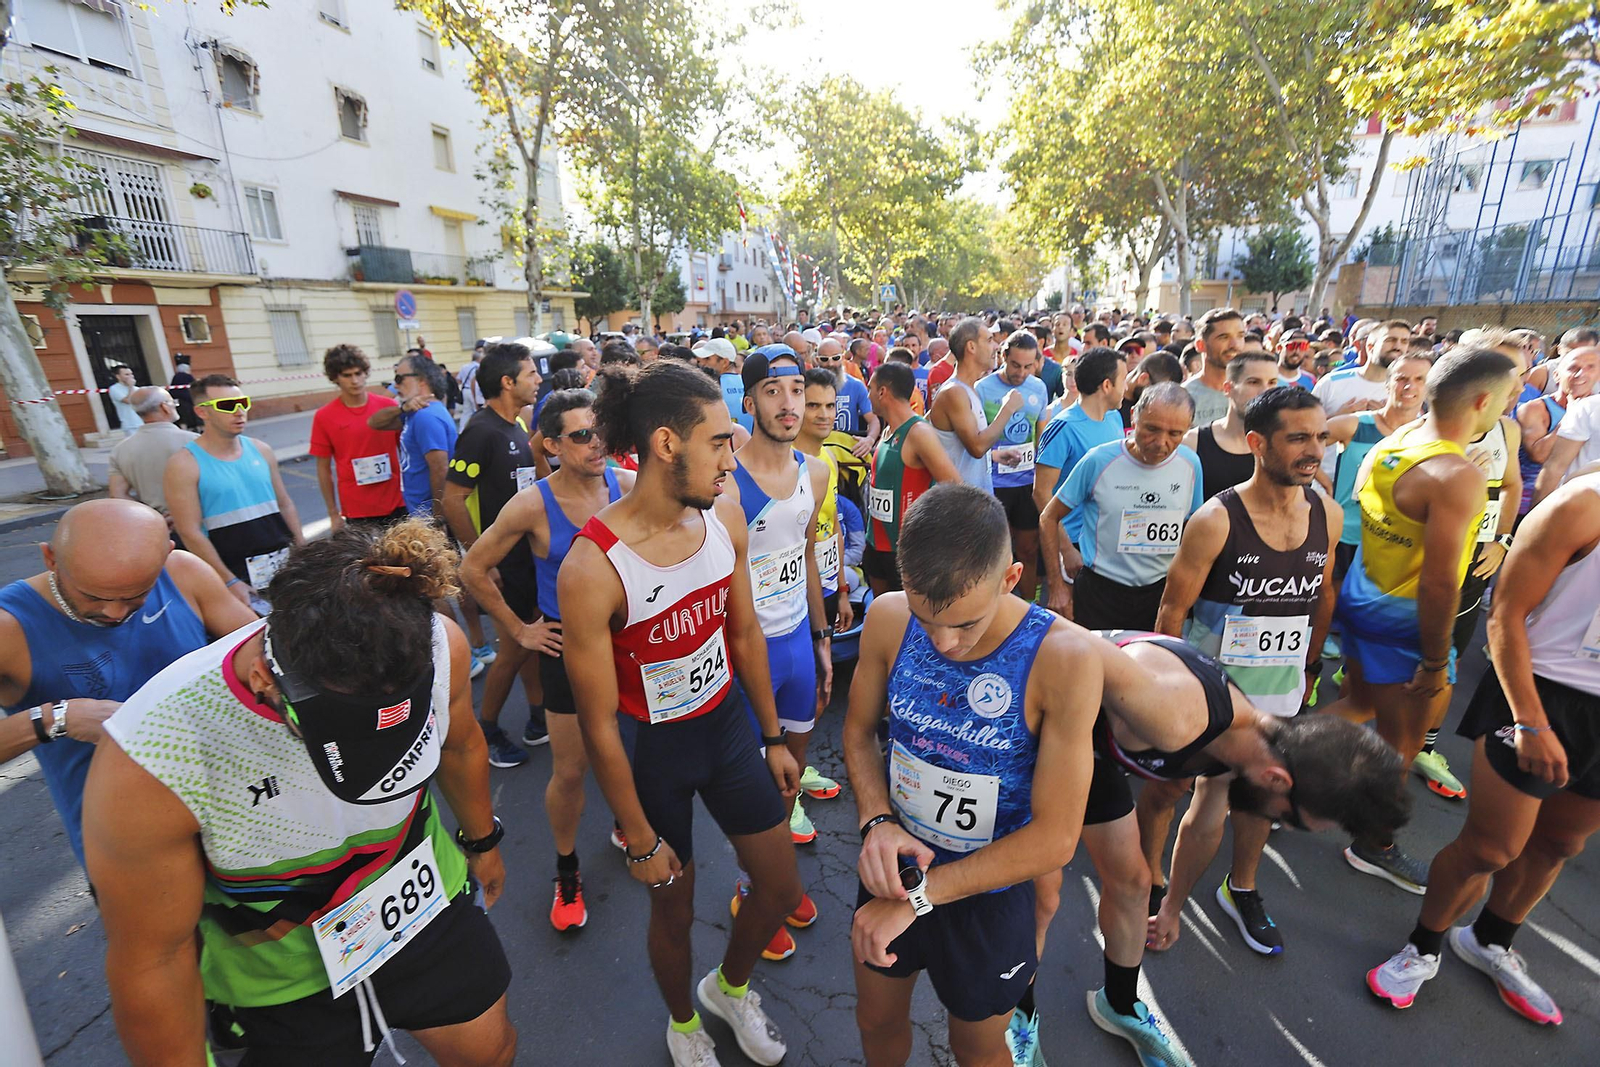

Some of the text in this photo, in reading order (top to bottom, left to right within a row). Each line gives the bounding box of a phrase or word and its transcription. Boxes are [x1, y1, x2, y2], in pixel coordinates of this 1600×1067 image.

[374, 462, 386, 474] 37
[871, 496, 890, 513] 170
[1147, 523, 1179, 541] 663
[823, 545, 837, 568] 728
[1237, 552, 1261, 564] vive
[779, 554, 803, 585] 497
[1236, 573, 1324, 597] JUCAMP
[1258, 630, 1302, 652] 613
[689, 646, 724, 693] 524
[943, 775, 971, 789] DIEGO
[933, 789, 977, 831] 75
[381, 864, 435, 931] 689
